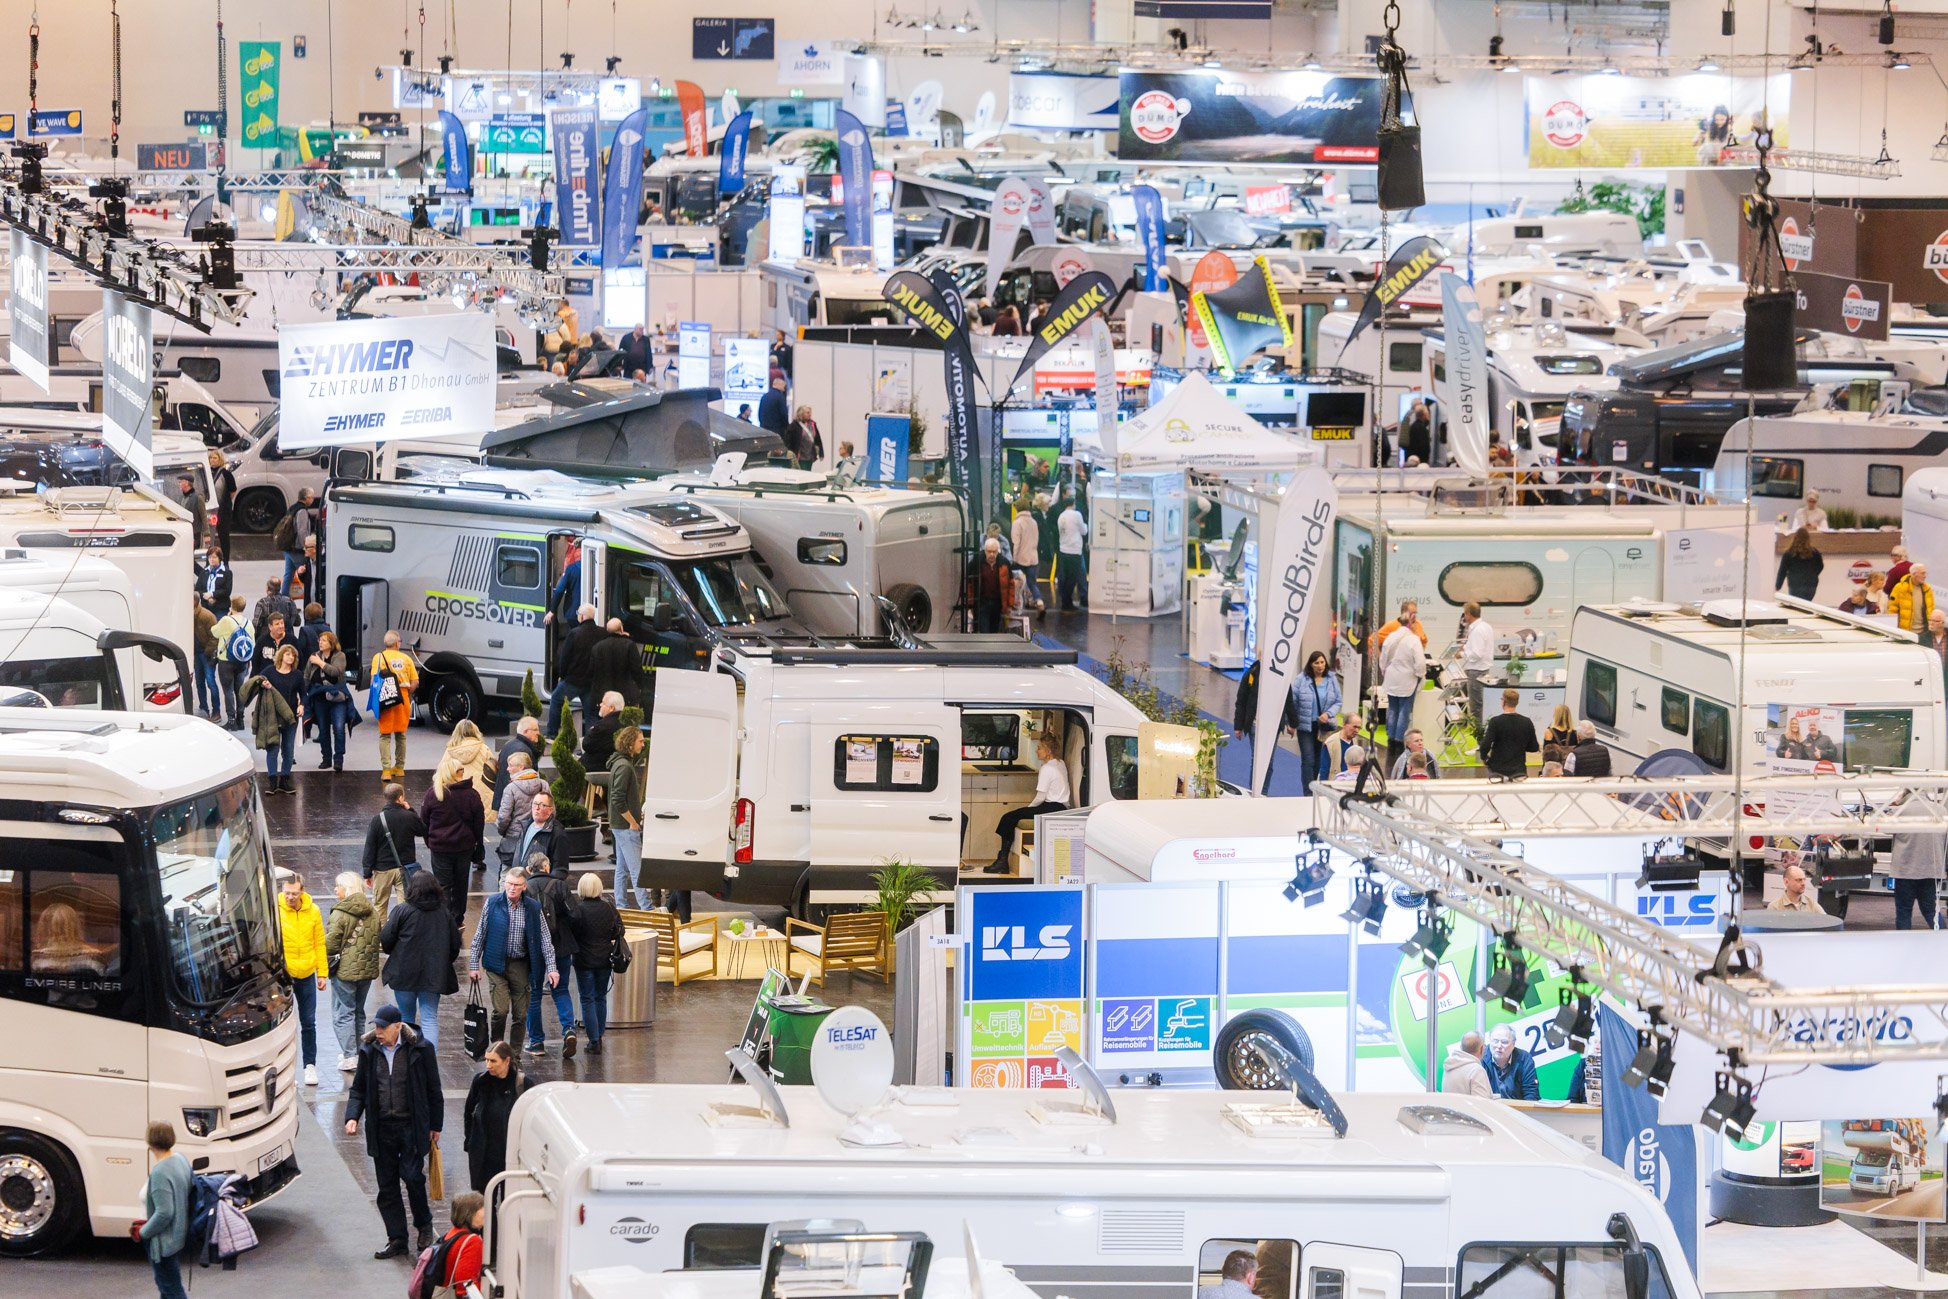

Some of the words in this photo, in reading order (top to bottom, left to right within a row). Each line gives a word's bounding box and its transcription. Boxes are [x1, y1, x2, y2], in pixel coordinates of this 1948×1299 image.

[694, 19, 727, 27] GALERIA
[793, 60, 831, 71] AHORN
[46, 117, 66, 127] WAVE
[153, 149, 191, 168] NEU
[1795, 289, 1808, 310] fo
[1040, 282, 1110, 346] EMUK!
[1843, 300, 1877, 318] bürstner
[107, 314, 147, 384] MORELO
[312, 339, 414, 377] HYMER
[1456, 327, 1476, 425] easydriver
[308, 377, 383, 398] ZENTRUM
[411, 373, 462, 391] Dhonau
[465, 371, 490, 386] GmbH
[336, 412, 386, 430] HYMER
[411, 406, 453, 425] ERIBA
[1205, 423, 1243, 433] SECURE
[1312, 429, 1351, 440] EMUK
[879, 437, 897, 489] MER
[1269, 498, 1331, 677] roadBirds
[1396, 577, 1417, 590] Zeit
[425, 595, 536, 628] CROSSOVER
[1755, 678, 1795, 688] FENDT
[1193, 848, 1236, 861] Engelhard
[1637, 894, 1718, 926] KLS
[982, 925, 1073, 961] KLS
[25, 977, 77, 989] EMPIRE
[82, 981, 122, 992] LINER
[972, 1044, 1025, 1053] Umwelttechnik
[1029, 1043, 1058, 1052] Auflast
[1103, 1040, 1147, 1050] Reisemobile
[1158, 1040, 1203, 1050] Reisemobile
[609, 1222, 660, 1236] carado
